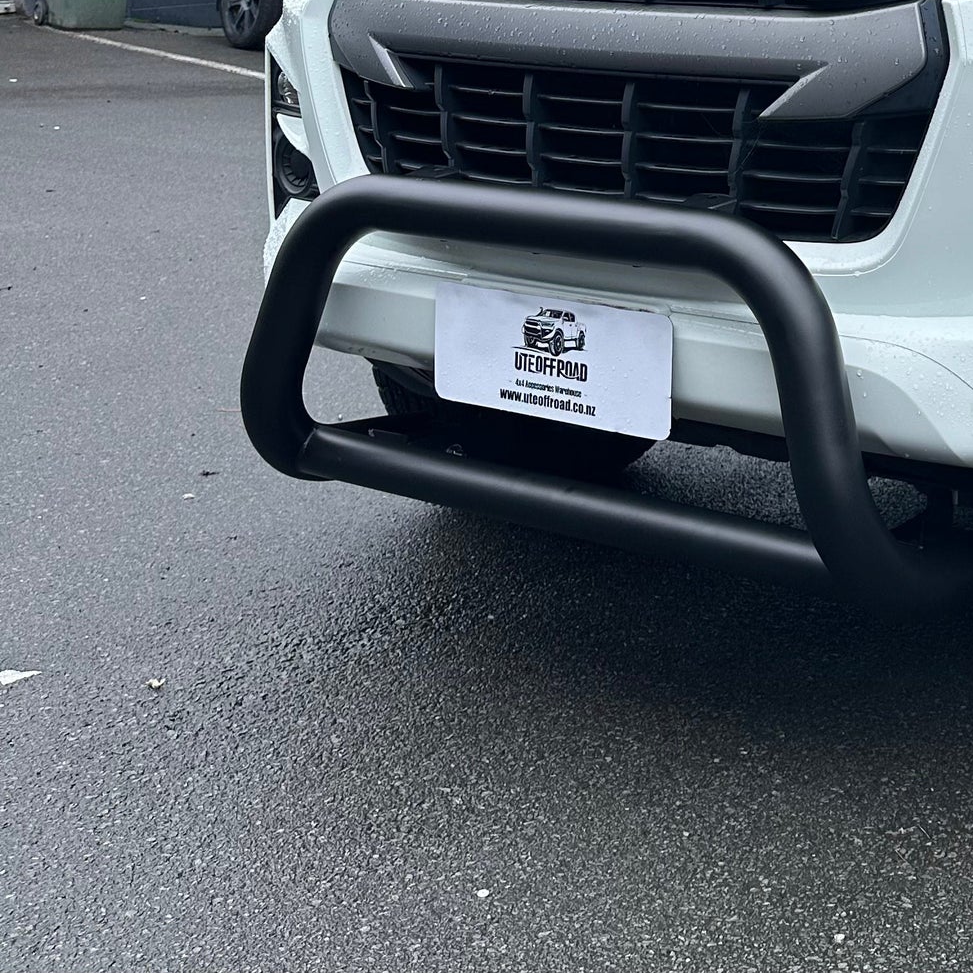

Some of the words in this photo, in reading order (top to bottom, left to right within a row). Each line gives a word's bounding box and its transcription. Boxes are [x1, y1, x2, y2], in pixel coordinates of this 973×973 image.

[514, 351, 588, 382] UTEOFFROAD
[499, 388, 596, 417] www.uteoffroad.co.nz
[525, 380, 554, 393] Accessories
[555, 385, 582, 398] Warehouse
